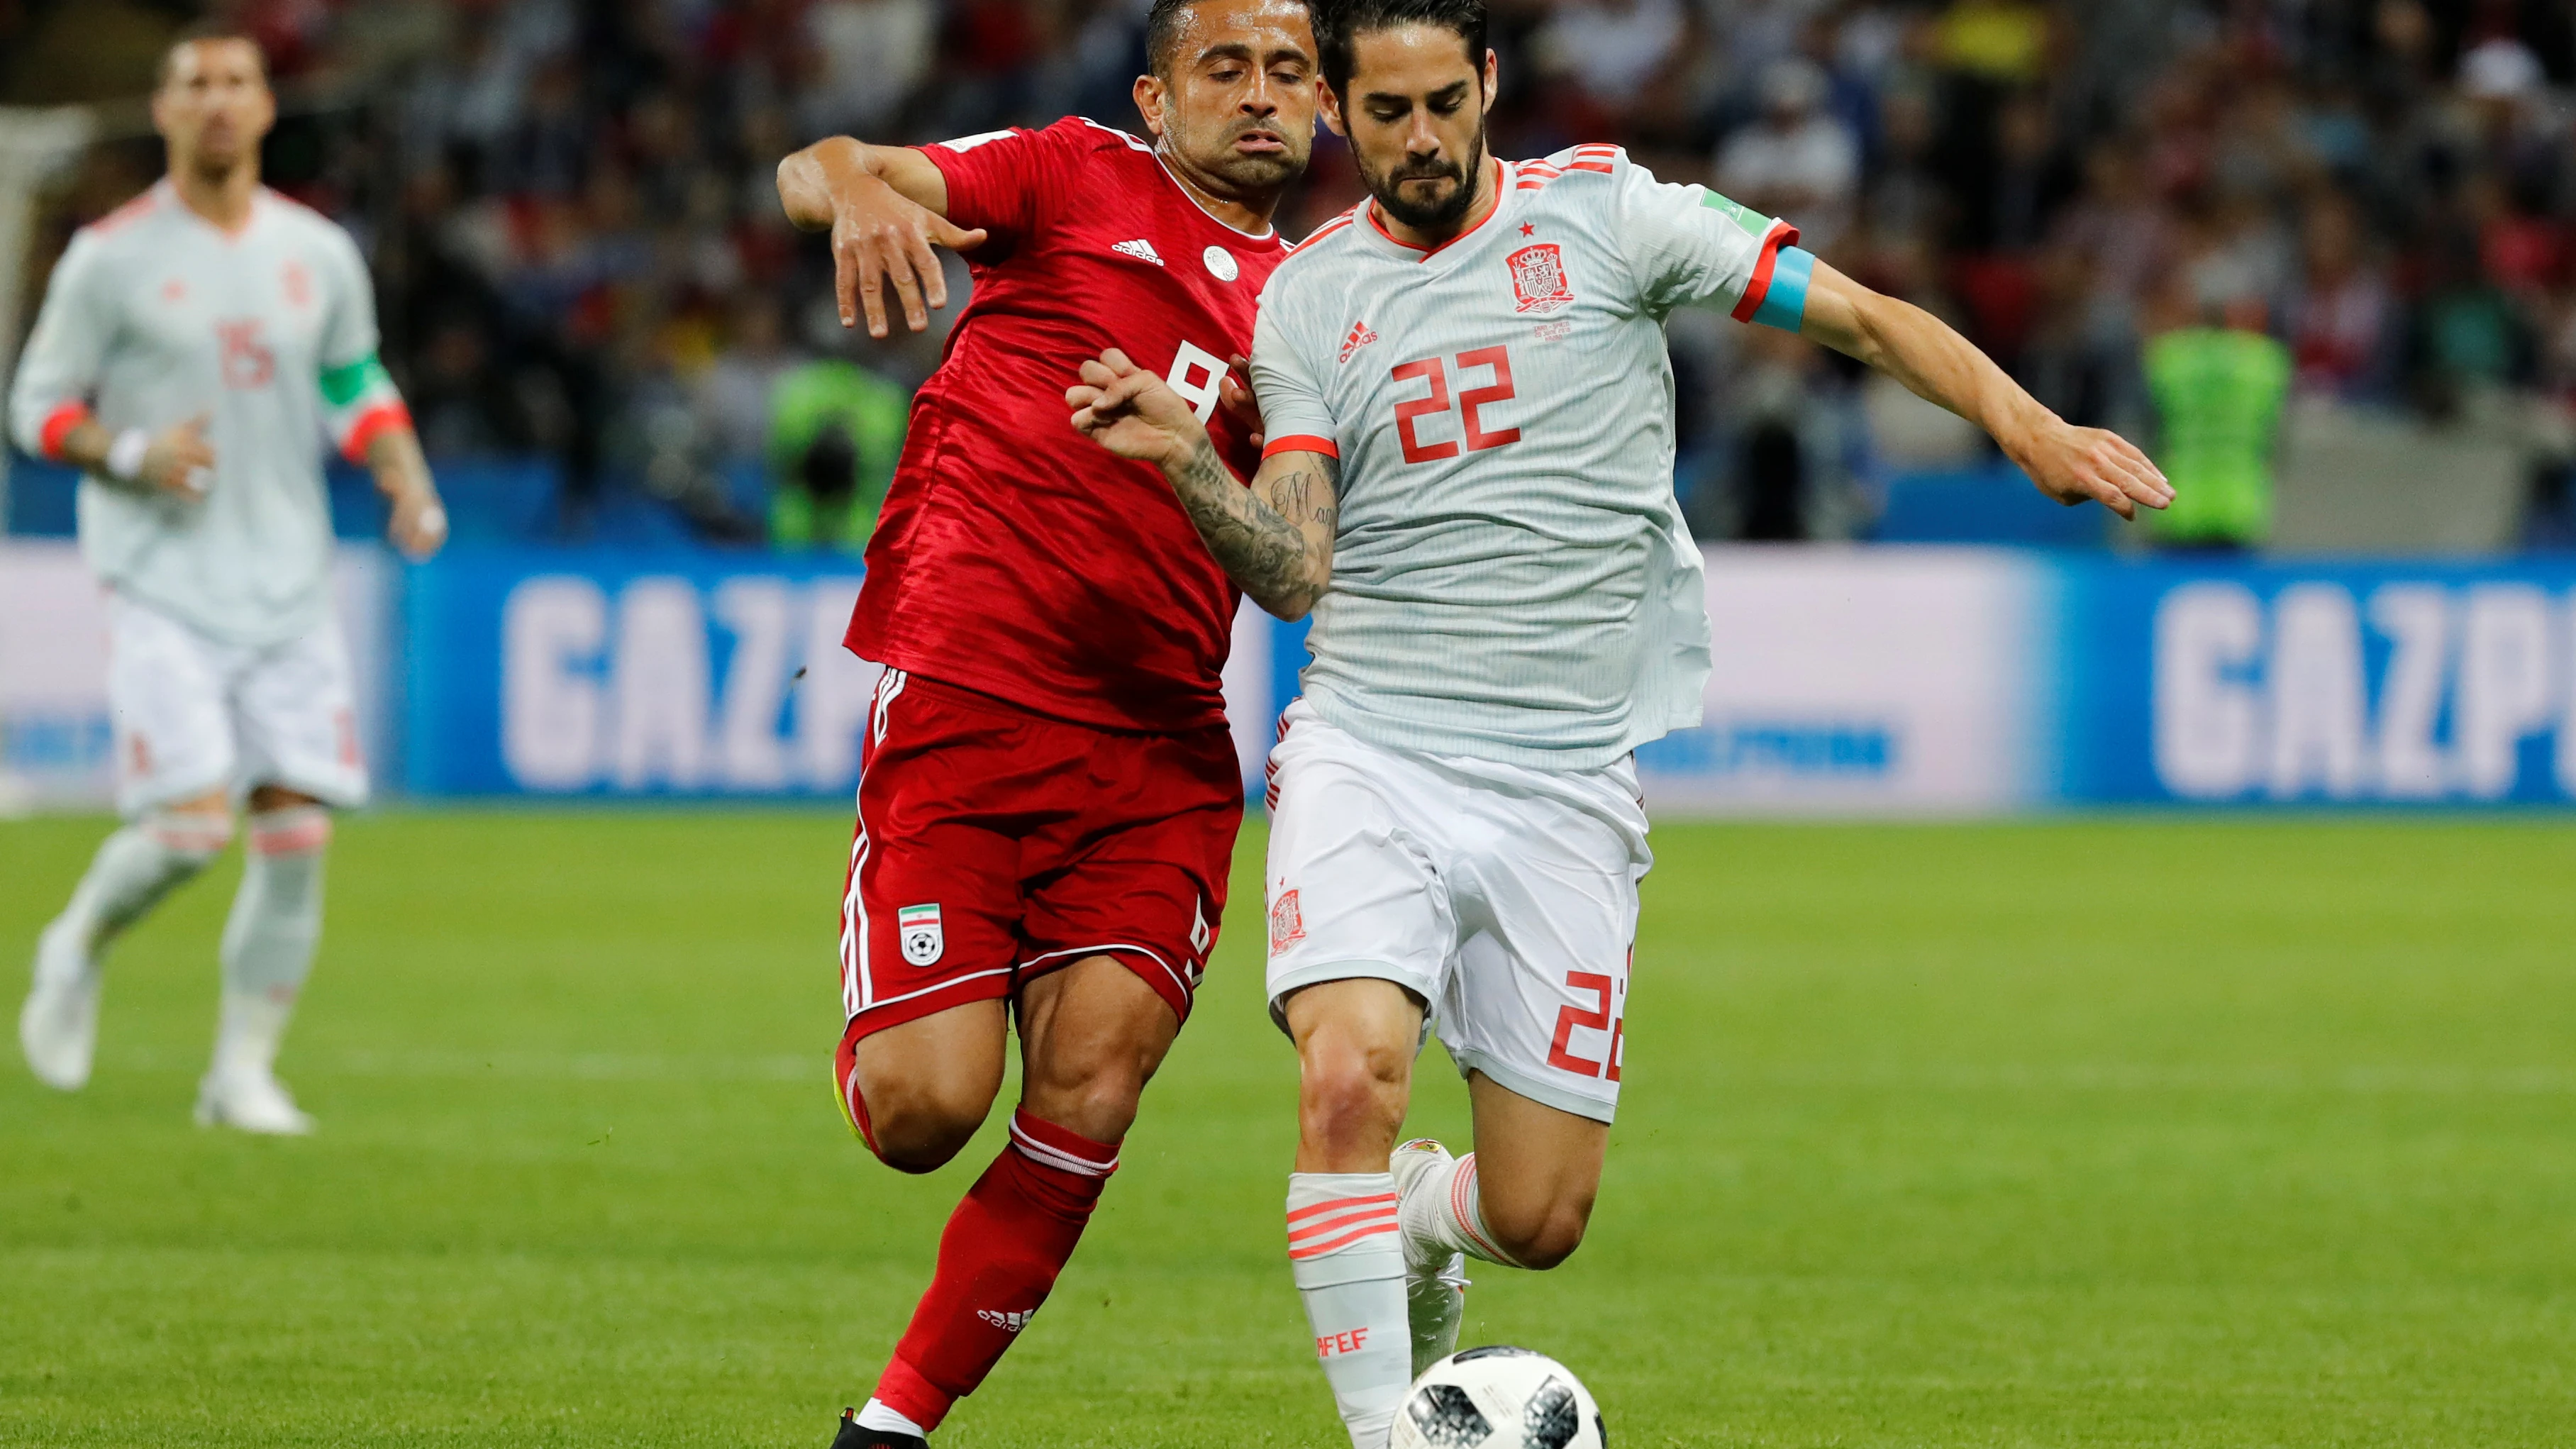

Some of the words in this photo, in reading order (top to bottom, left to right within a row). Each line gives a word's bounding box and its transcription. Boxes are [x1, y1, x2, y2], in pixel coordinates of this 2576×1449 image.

[1111, 244, 1165, 267] adidas
[1339, 331, 1378, 363] addas
[1392, 345, 1521, 464] 22
[501, 576, 884, 789] GAZP
[2151, 580, 2576, 799] GAZP
[1547, 970, 1623, 1082] 2
[977, 1310, 1021, 1331] adid
